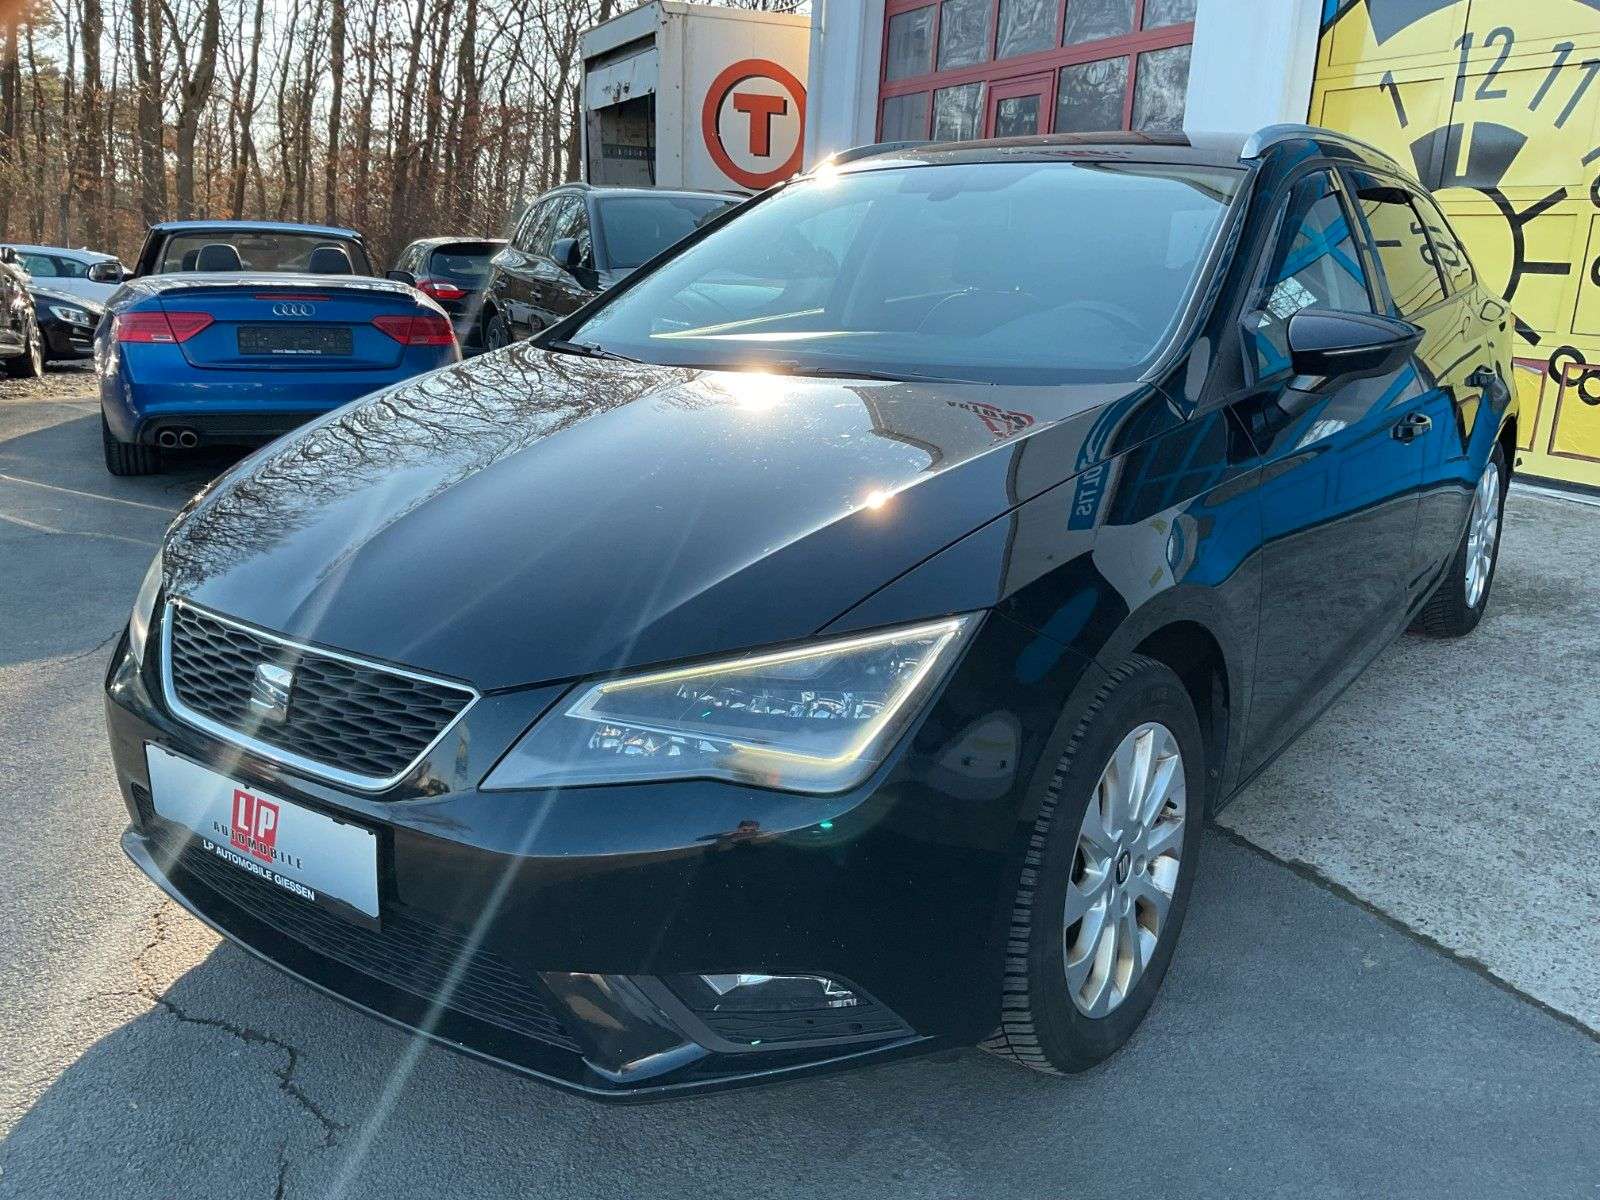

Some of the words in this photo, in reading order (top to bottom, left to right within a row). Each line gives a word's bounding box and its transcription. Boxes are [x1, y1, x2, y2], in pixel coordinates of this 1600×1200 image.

[1453, 26, 1515, 103] 12
[1527, 41, 1600, 130] 11
[733, 92, 788, 158] T
[1379, 70, 1409, 129] 1
[213, 821, 303, 871] AUTOMOBILE
[238, 796, 276, 838] LP
[202, 839, 215, 851] LP
[216, 846, 273, 881] AUTOMOBILE
[274, 874, 316, 901] GIESSEN
